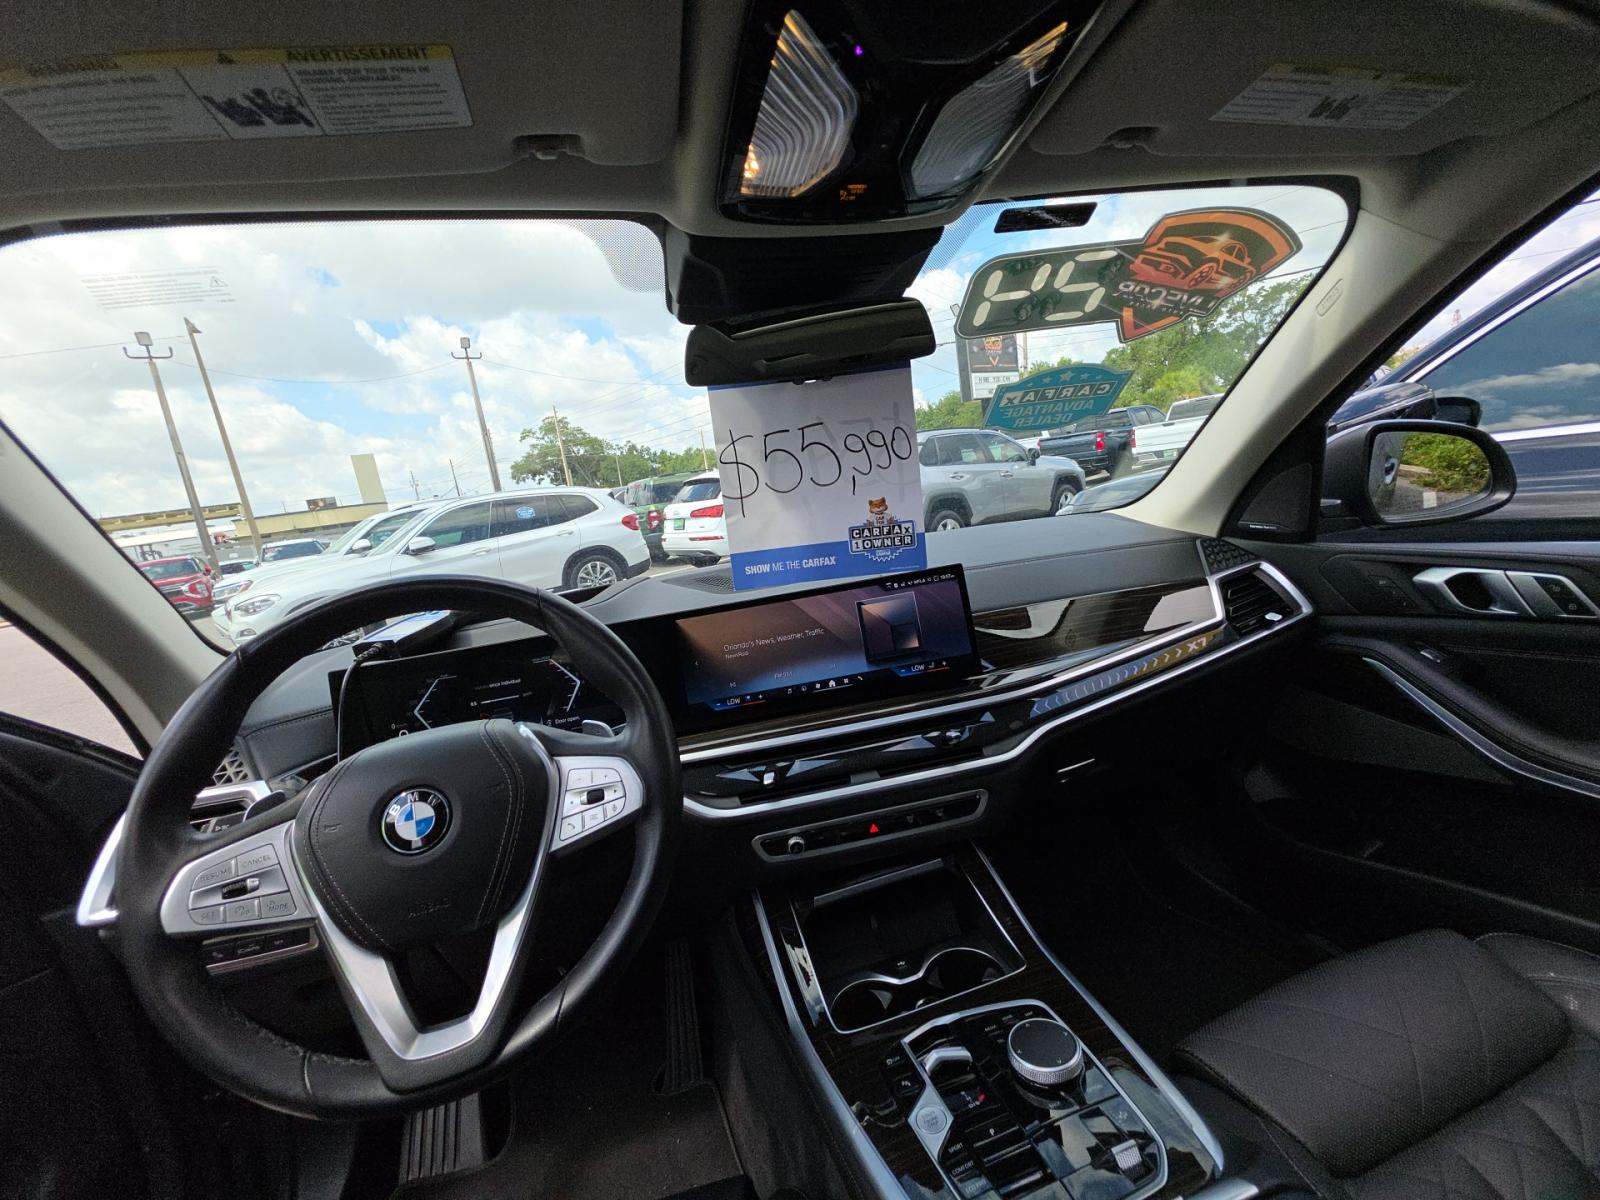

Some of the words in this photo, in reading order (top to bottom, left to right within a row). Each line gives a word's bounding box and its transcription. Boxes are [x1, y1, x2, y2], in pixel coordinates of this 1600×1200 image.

[286, 46, 428, 62] AVERTISSEMENT
[719, 422, 912, 518] $55,990
[852, 525, 912, 538] CARFAX
[745, 564, 770, 575] SHOW
[772, 562, 784, 571] ME
[786, 560, 801, 570] THE
[802, 556, 837, 568] CARFAX
[1187, 636, 1207, 654] X7
[726, 698, 741, 706] LOW
[388, 791, 441, 816] BMW
